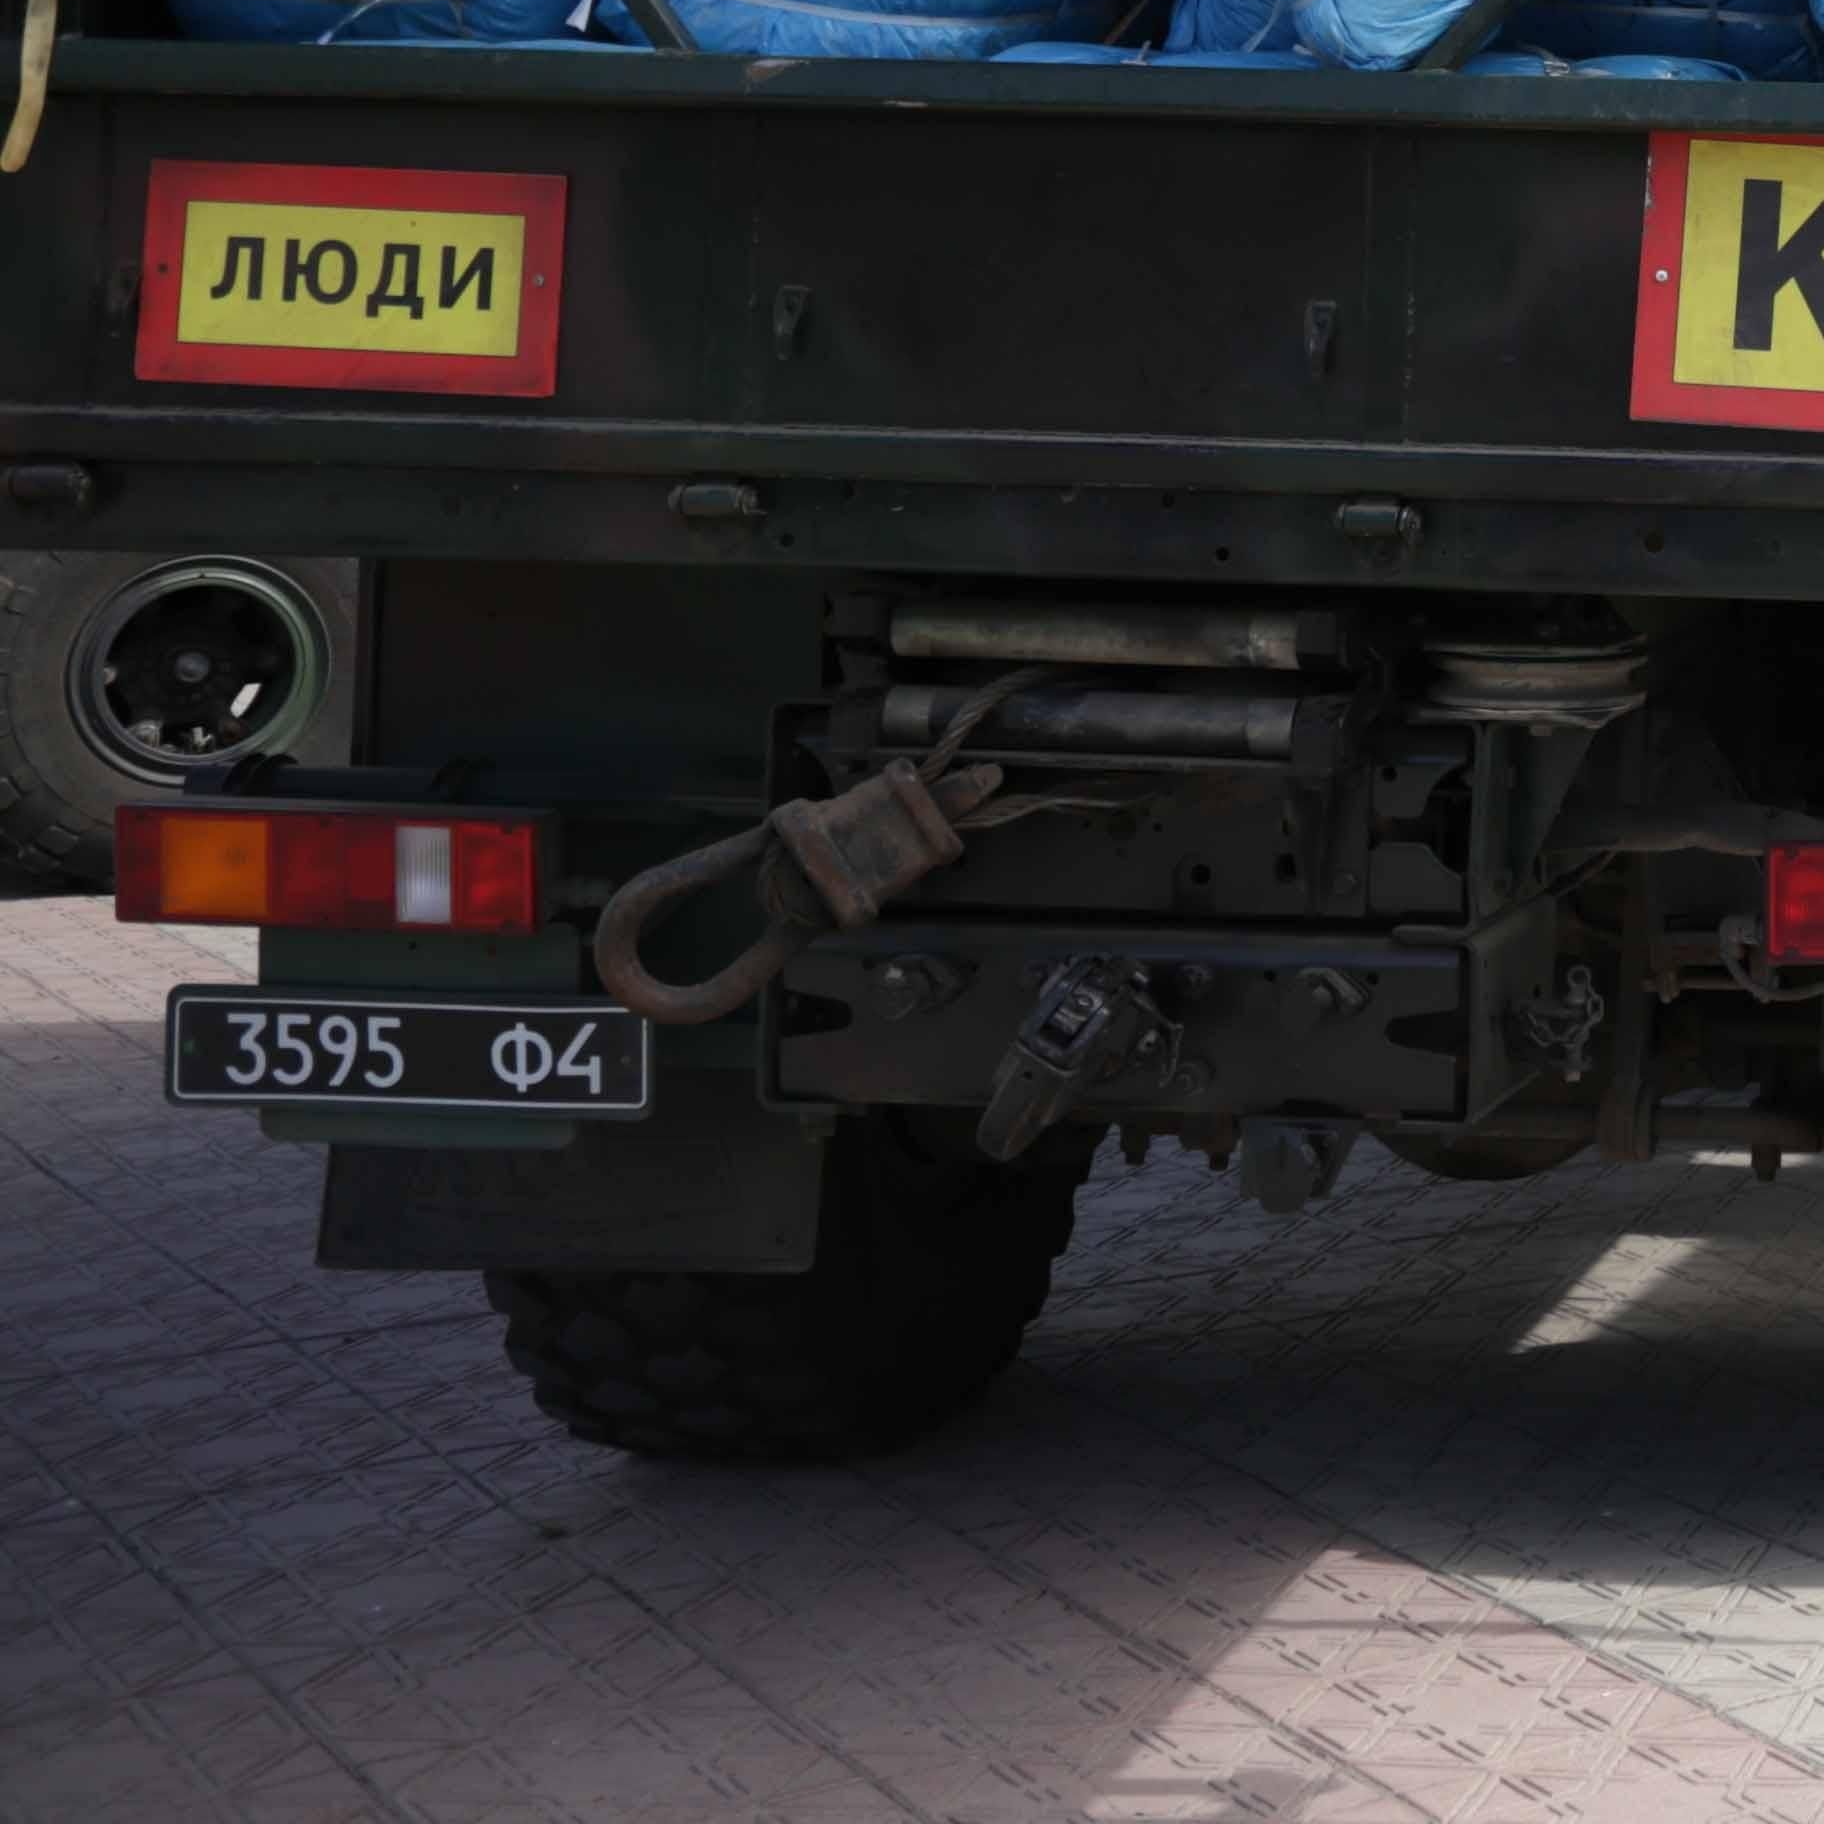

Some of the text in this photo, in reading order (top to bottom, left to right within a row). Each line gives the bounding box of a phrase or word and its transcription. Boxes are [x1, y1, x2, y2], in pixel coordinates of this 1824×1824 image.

[209, 236, 496, 320] ЛЮДИ
[225, 1012, 604, 1094] 3595 Ф4
